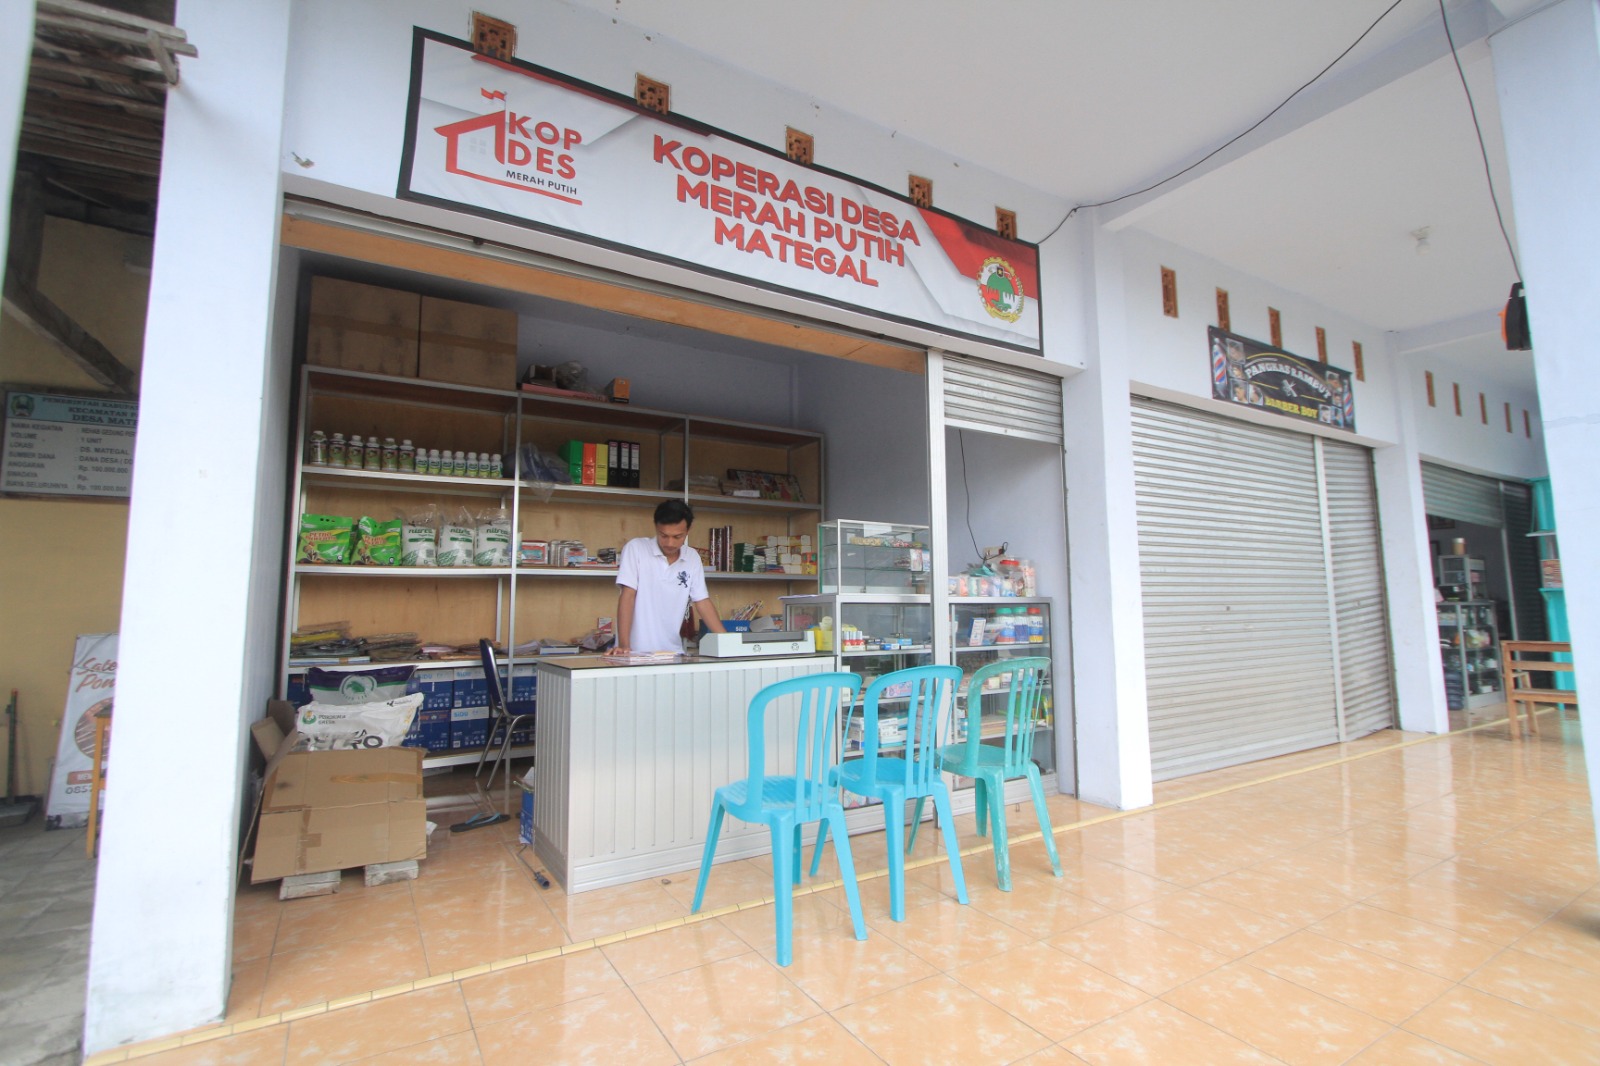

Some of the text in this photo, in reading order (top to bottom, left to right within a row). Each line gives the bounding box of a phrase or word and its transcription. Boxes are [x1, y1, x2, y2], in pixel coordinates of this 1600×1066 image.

[508, 111, 582, 150] KOP
[507, 138, 577, 180] DES
[506, 169, 578, 195] MERAH PUTIH
[653, 134, 921, 247] KOPERASI DESA
[676, 174, 905, 267] MERAH PUTIH
[714, 216, 879, 287] MATEGAL
[1244, 363, 1332, 399] PANGKAS RAMBUT
[68, 407, 128, 417] KECAMATAN
[72, 414, 104, 424] DESA
[1264, 395, 1319, 419] BARBER BOY
[9, 441, 34, 449] LOKASI
[10, 432, 38, 440] VOLUME
[38, 452, 56, 460] DANA
[94, 447, 130, 455] MATEGAL
